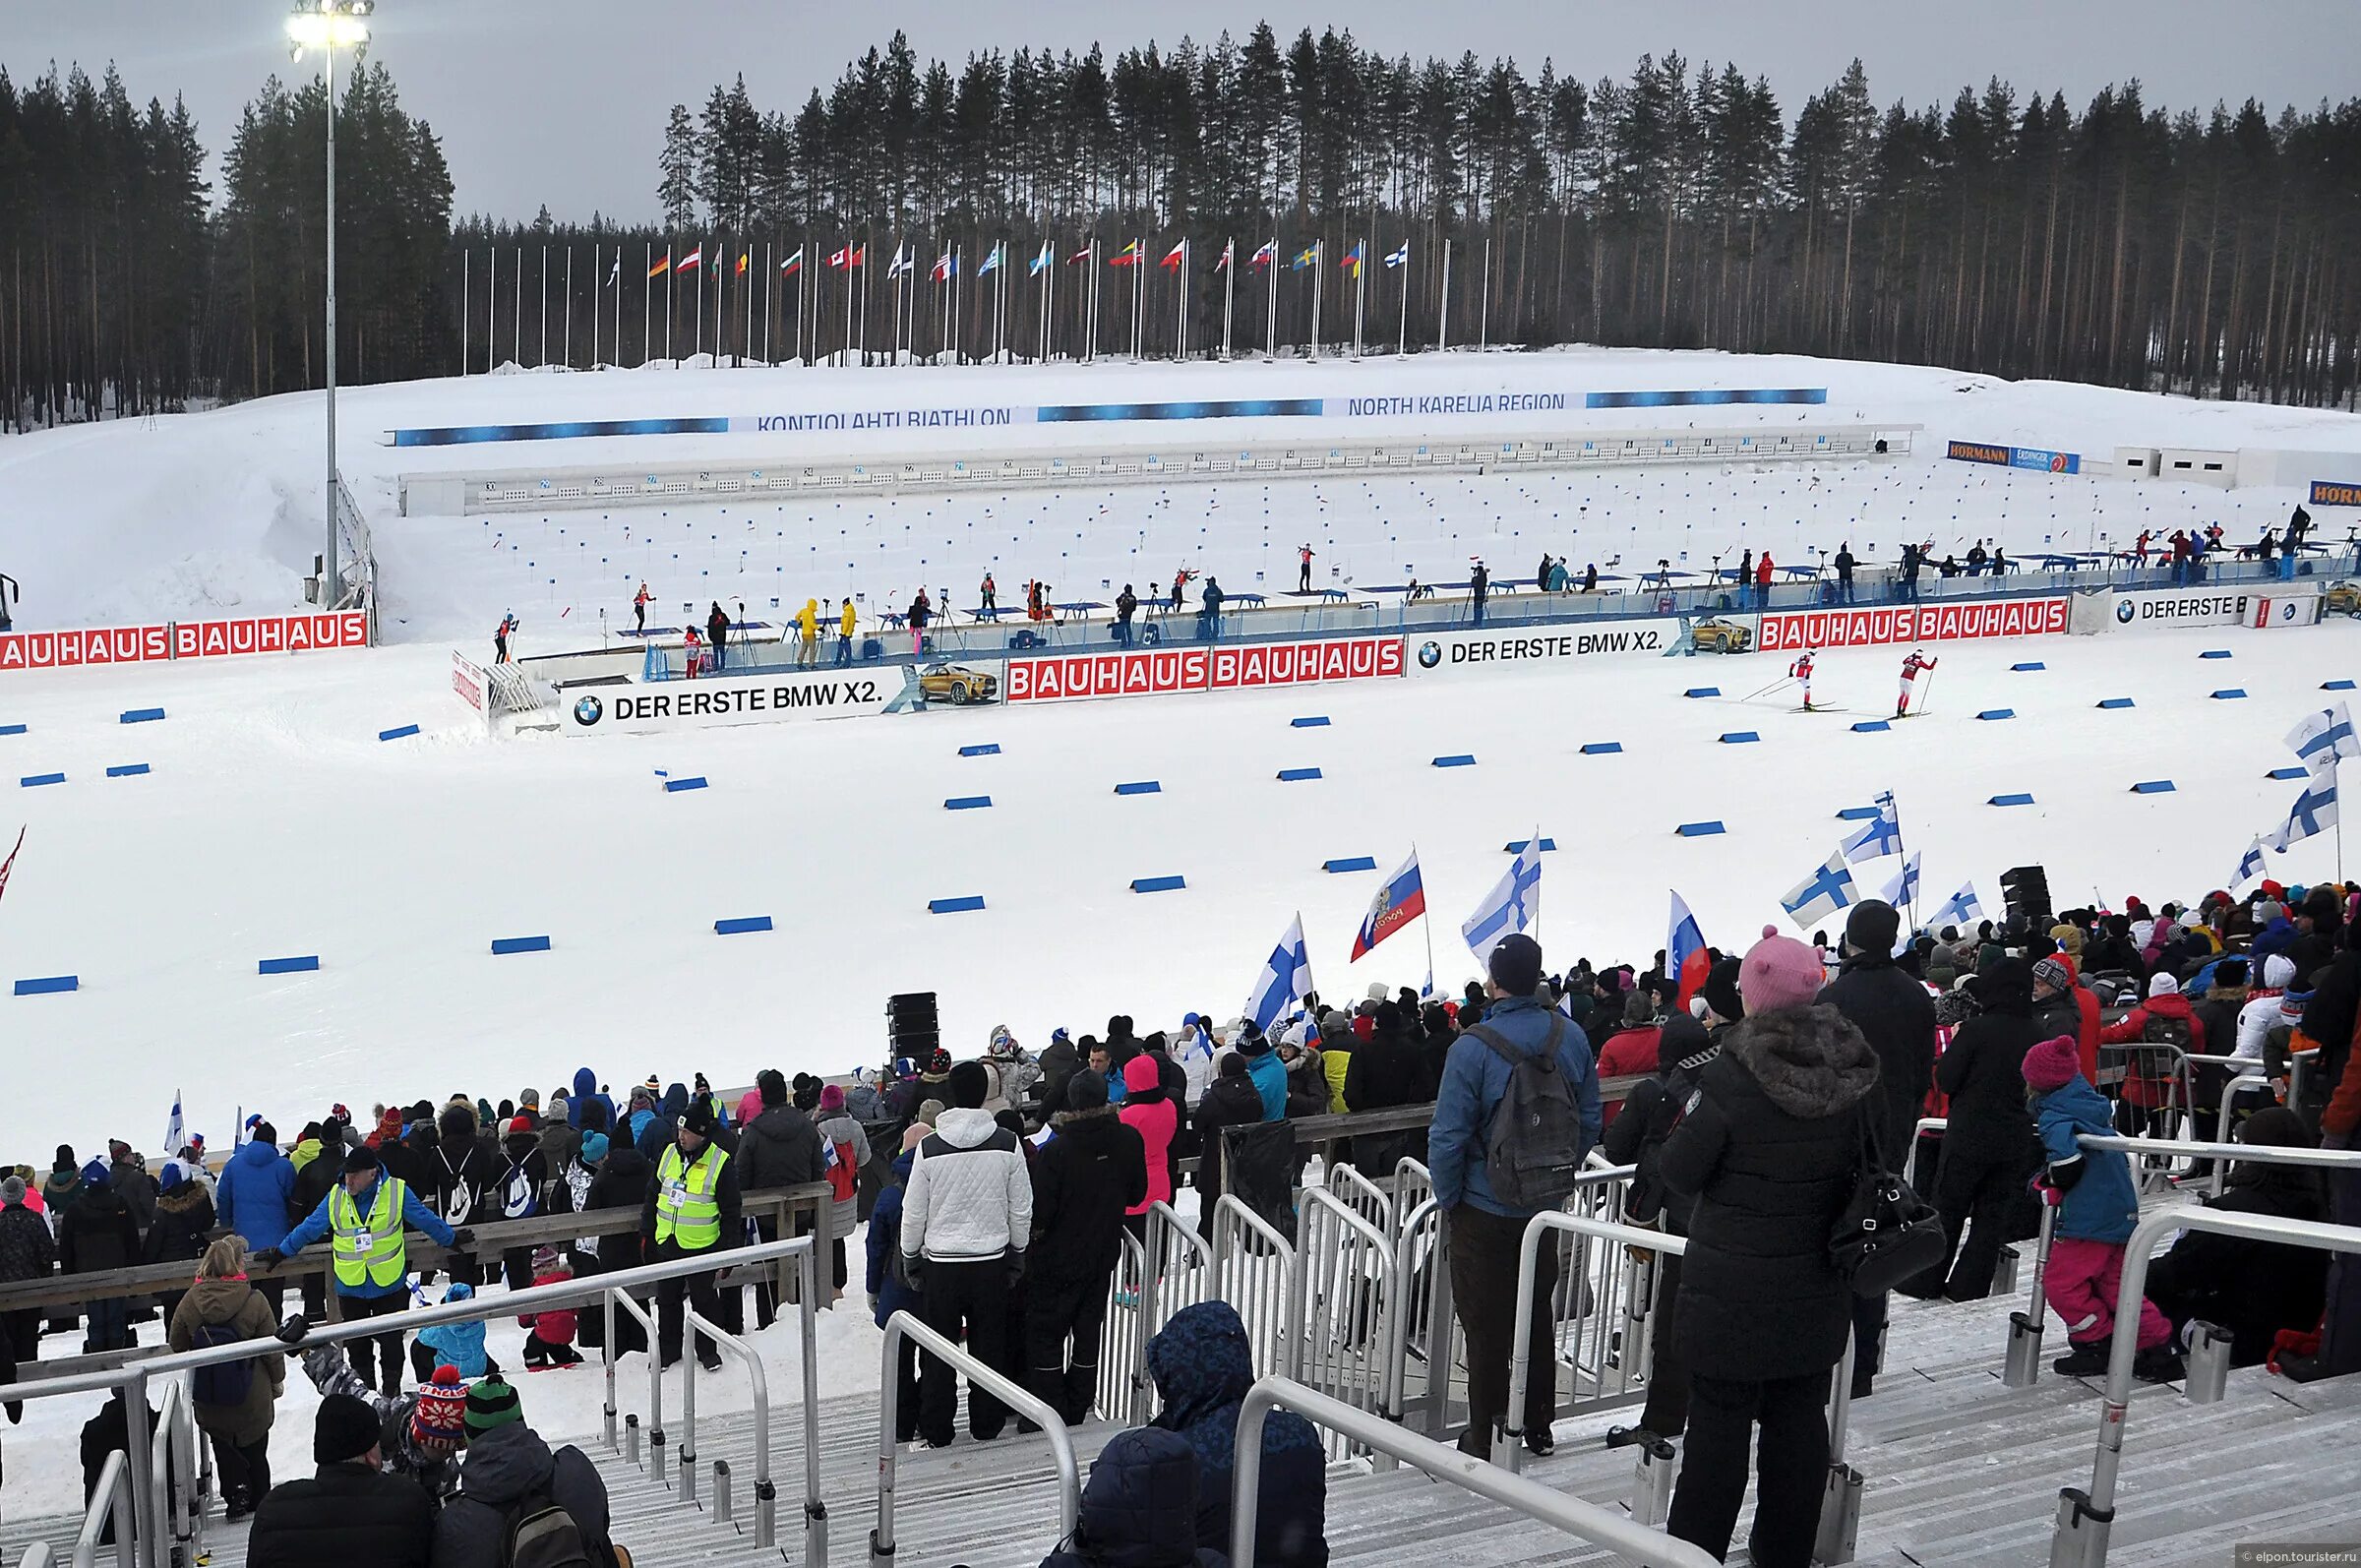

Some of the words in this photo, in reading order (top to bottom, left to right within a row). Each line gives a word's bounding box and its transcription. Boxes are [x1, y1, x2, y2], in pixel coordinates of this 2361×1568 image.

[1349, 397, 1414, 416] NORTH
[1420, 395, 1493, 413] KARELIA
[1499, 393, 1565, 411] REGION
[1920, 603, 2064, 637] BAUHAUS
[2142, 599, 2175, 619] DER
[2178, 596, 2233, 617] ERSTE
[177, 617, 364, 654] BAUHAUS
[1762, 612, 1913, 645] BAUHAUS
[1216, 643, 1399, 682] BAUHAUS
[1451, 641, 1496, 663] DER
[1500, 636, 1572, 659] ERSTE
[1577, 632, 1630, 654] BMW
[1631, 631, 1663, 651] X2.
[1010, 656, 1205, 695] BAUHAUS
[616, 696, 671, 720] DER
[677, 690, 766, 717] ERSTE
[774, 683, 838, 709] BMW
[843, 680, 882, 704] X2.
